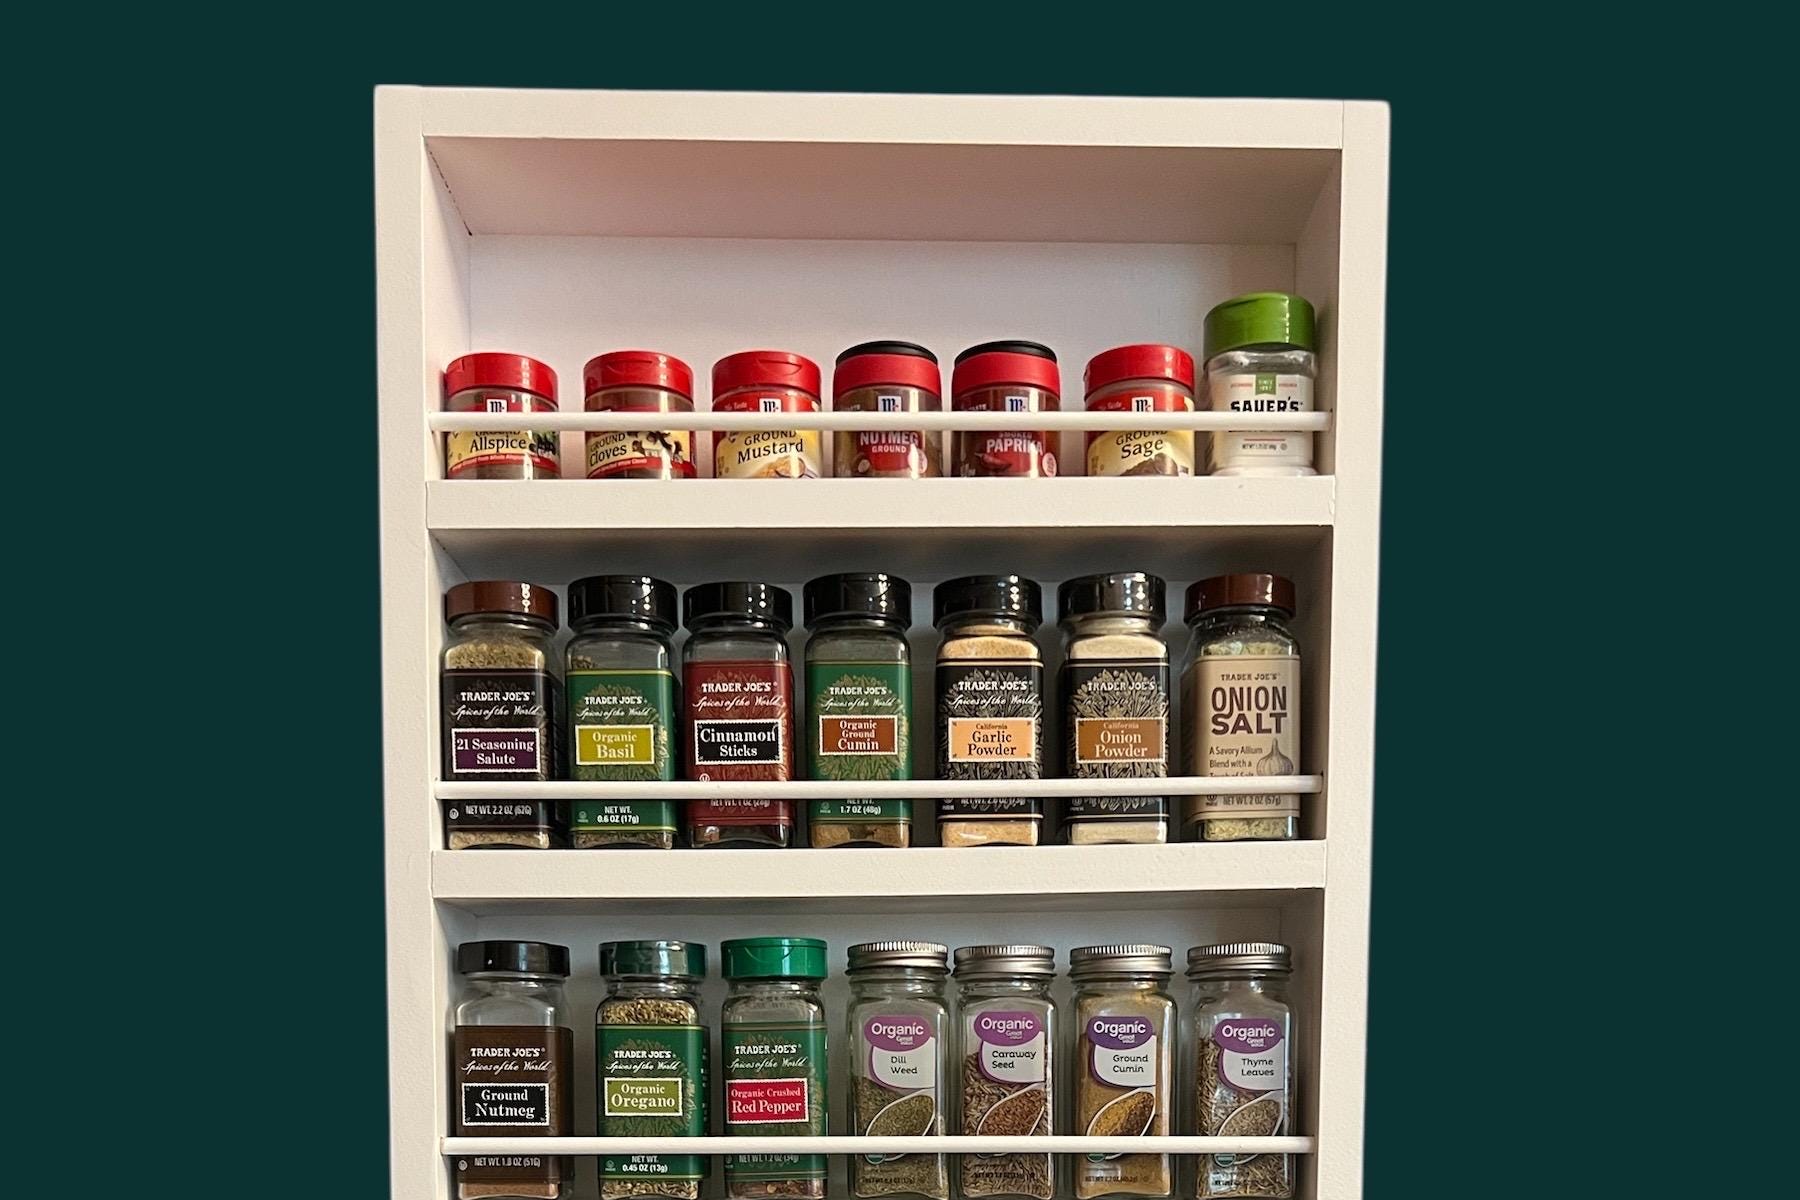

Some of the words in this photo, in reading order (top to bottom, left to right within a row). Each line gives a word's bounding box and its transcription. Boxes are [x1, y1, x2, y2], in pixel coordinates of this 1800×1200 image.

[744, 431, 797, 446] GROUND
[860, 431, 921, 447] NUTMEG
[470, 436, 527, 454] Allspice
[737, 438, 804, 464] Mustard
[871, 445, 907, 453] GROUND
[986, 438, 1044, 456] PAPRIKA
[1121, 439, 1164, 459] Sage
[589, 444, 627, 467] Cloves
[1220, 673, 1252, 681] TRADER
[1254, 673, 1279, 681] JOE'S
[701, 682, 741, 693] TRADER
[743, 681, 772, 692] JOE'S
[829, 687, 862, 696] TRADER
[864, 687, 887, 696] JOE'S
[958, 681, 998, 691] TRADER
[1000, 681, 1028, 691] JOE'S
[1087, 682, 1126, 691] TRADER
[1129, 682, 1156, 691] JOE'S
[460, 691, 500, 702] TRADER
[502, 691, 531, 702] JOE'S
[584, 696, 618, 705] TRADER
[619, 696, 643, 705] JOE'S
[1211, 686, 1288, 713] ONION
[839, 720, 878, 731] Organic
[1211, 712, 1288, 736] SALT
[592, 731, 638, 743] Organic
[700, 728, 777, 743] Cinnamon
[841, 730, 876, 739] Ground
[972, 731, 1013, 743] Garlic
[1100, 730, 1142, 744] Onion
[457, 739, 471, 750] 21
[472, 738, 535, 752] Seasoning
[719, 744, 758, 758] Sticks
[837, 739, 880, 751] Cumin
[967, 743, 1018, 756] Powder
[1095, 744, 1148, 758] Powder
[597, 744, 636, 759] Basil
[477, 753, 516, 765] Salute
[604, 806, 618, 814] NET
[610, 815, 620, 823] OZ
[871, 1022, 925, 1039] Organic
[980, 1017, 1034, 1033] Organic
[1093, 1021, 1147, 1037] Organic
[1221, 1024, 1275, 1041] Organic
[470, 1048, 511, 1058] TRADER
[513, 1048, 541, 1057] JOE'S
[613, 1051, 648, 1059] TRADER
[648, 1050, 672, 1059] JOE'S
[734, 1045, 771, 1055] TRADER
[772, 1044, 798, 1054] JOE'S
[991, 1050, 1038, 1060] Caraway
[890, 1056, 908, 1064] Dill
[1112, 1054, 1149, 1063] Ground
[1240, 1058, 1274, 1068] Thyme
[890, 1067, 918, 1075] Weed
[991, 1061, 1015, 1069] Seed
[1112, 1065, 1144, 1073] Cumin
[481, 1089, 529, 1101] Ground
[621, 1083, 666, 1095] Organic
[731, 1089, 765, 1099] Organic
[766, 1087, 802, 1098] Crushed
[611, 1093, 676, 1110] Oregano
[732, 1101, 758, 1114] Red
[758, 1099, 802, 1115] Pepper
[474, 1102, 536, 1119] Nutmeg
[639, 1164, 649, 1172] OZ
